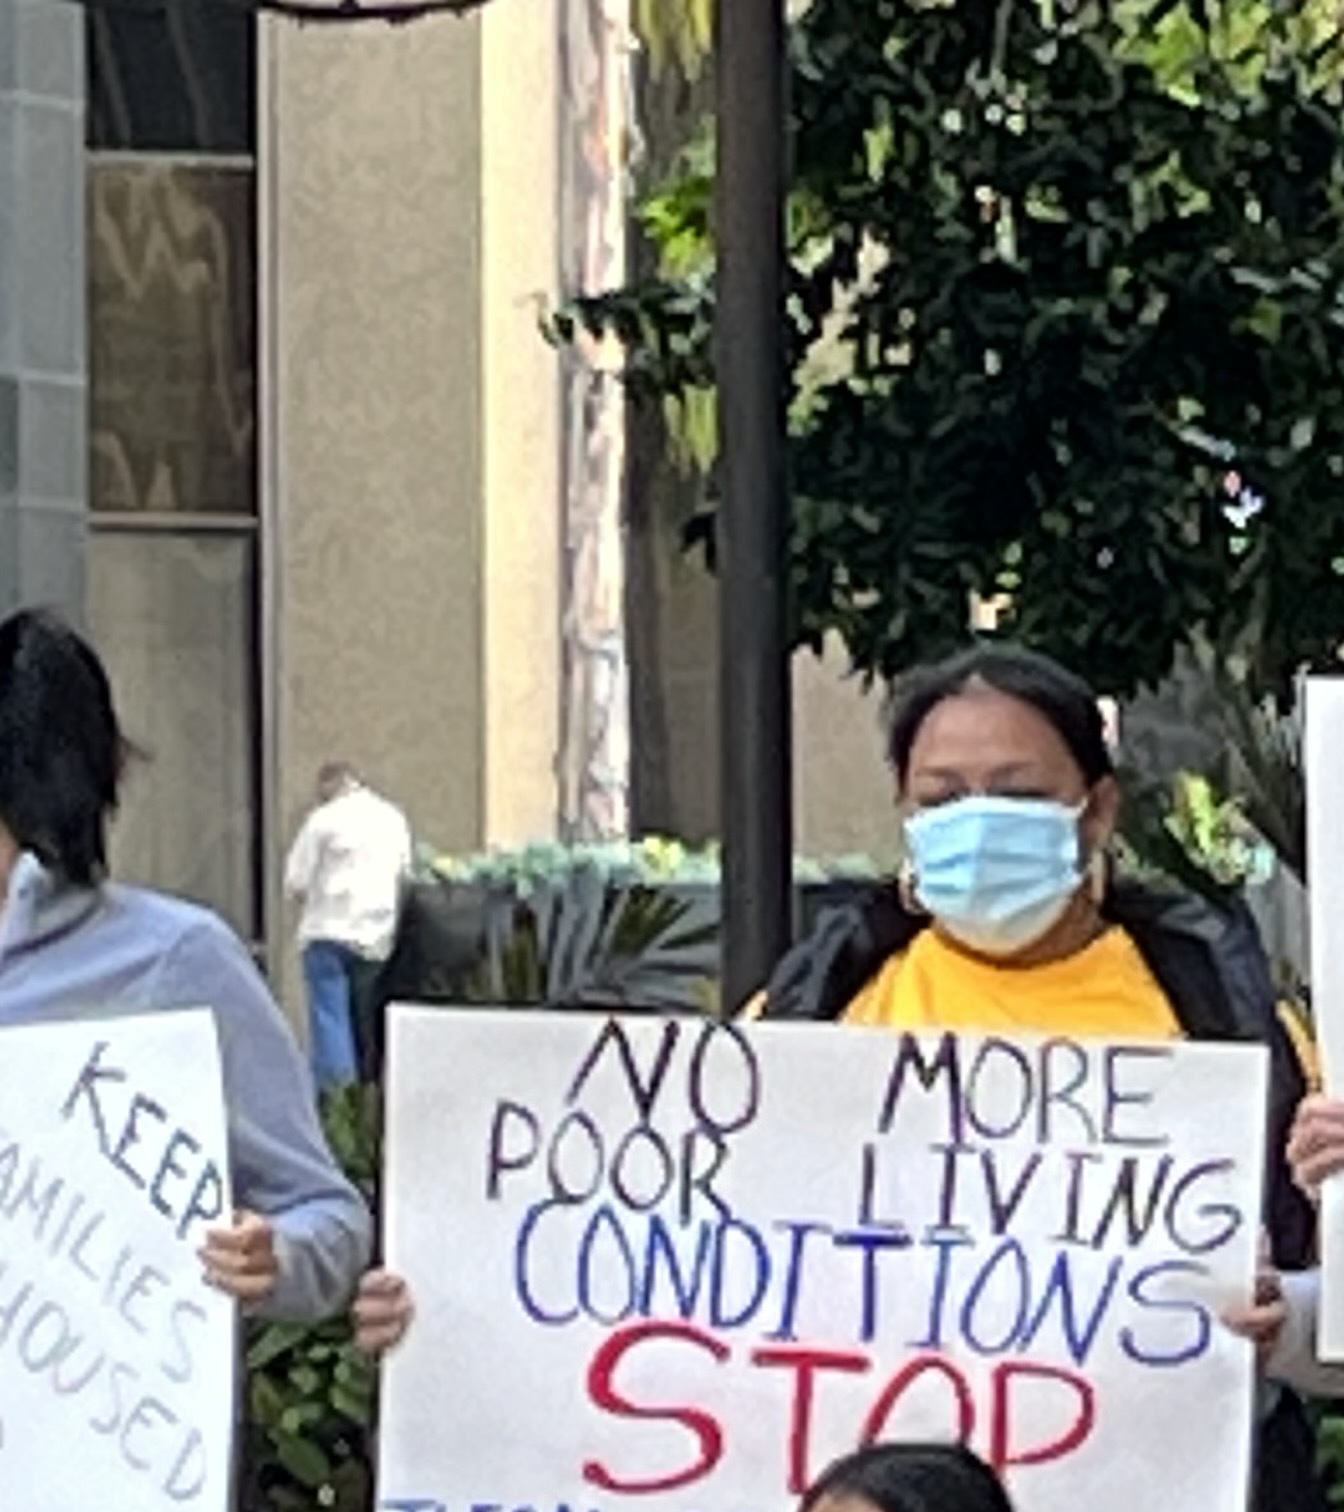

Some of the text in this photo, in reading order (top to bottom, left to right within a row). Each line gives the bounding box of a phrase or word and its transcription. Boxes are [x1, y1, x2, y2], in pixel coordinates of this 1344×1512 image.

[61, 1041, 223, 1240] KEEP
[565, 1018, 1174, 1147] NO MORE
[487, 1100, 1242, 1254] POOR LIVING
[514, 1199, 1212, 1368] CONDITIONS
[582, 1320, 1096, 1495] STOP
